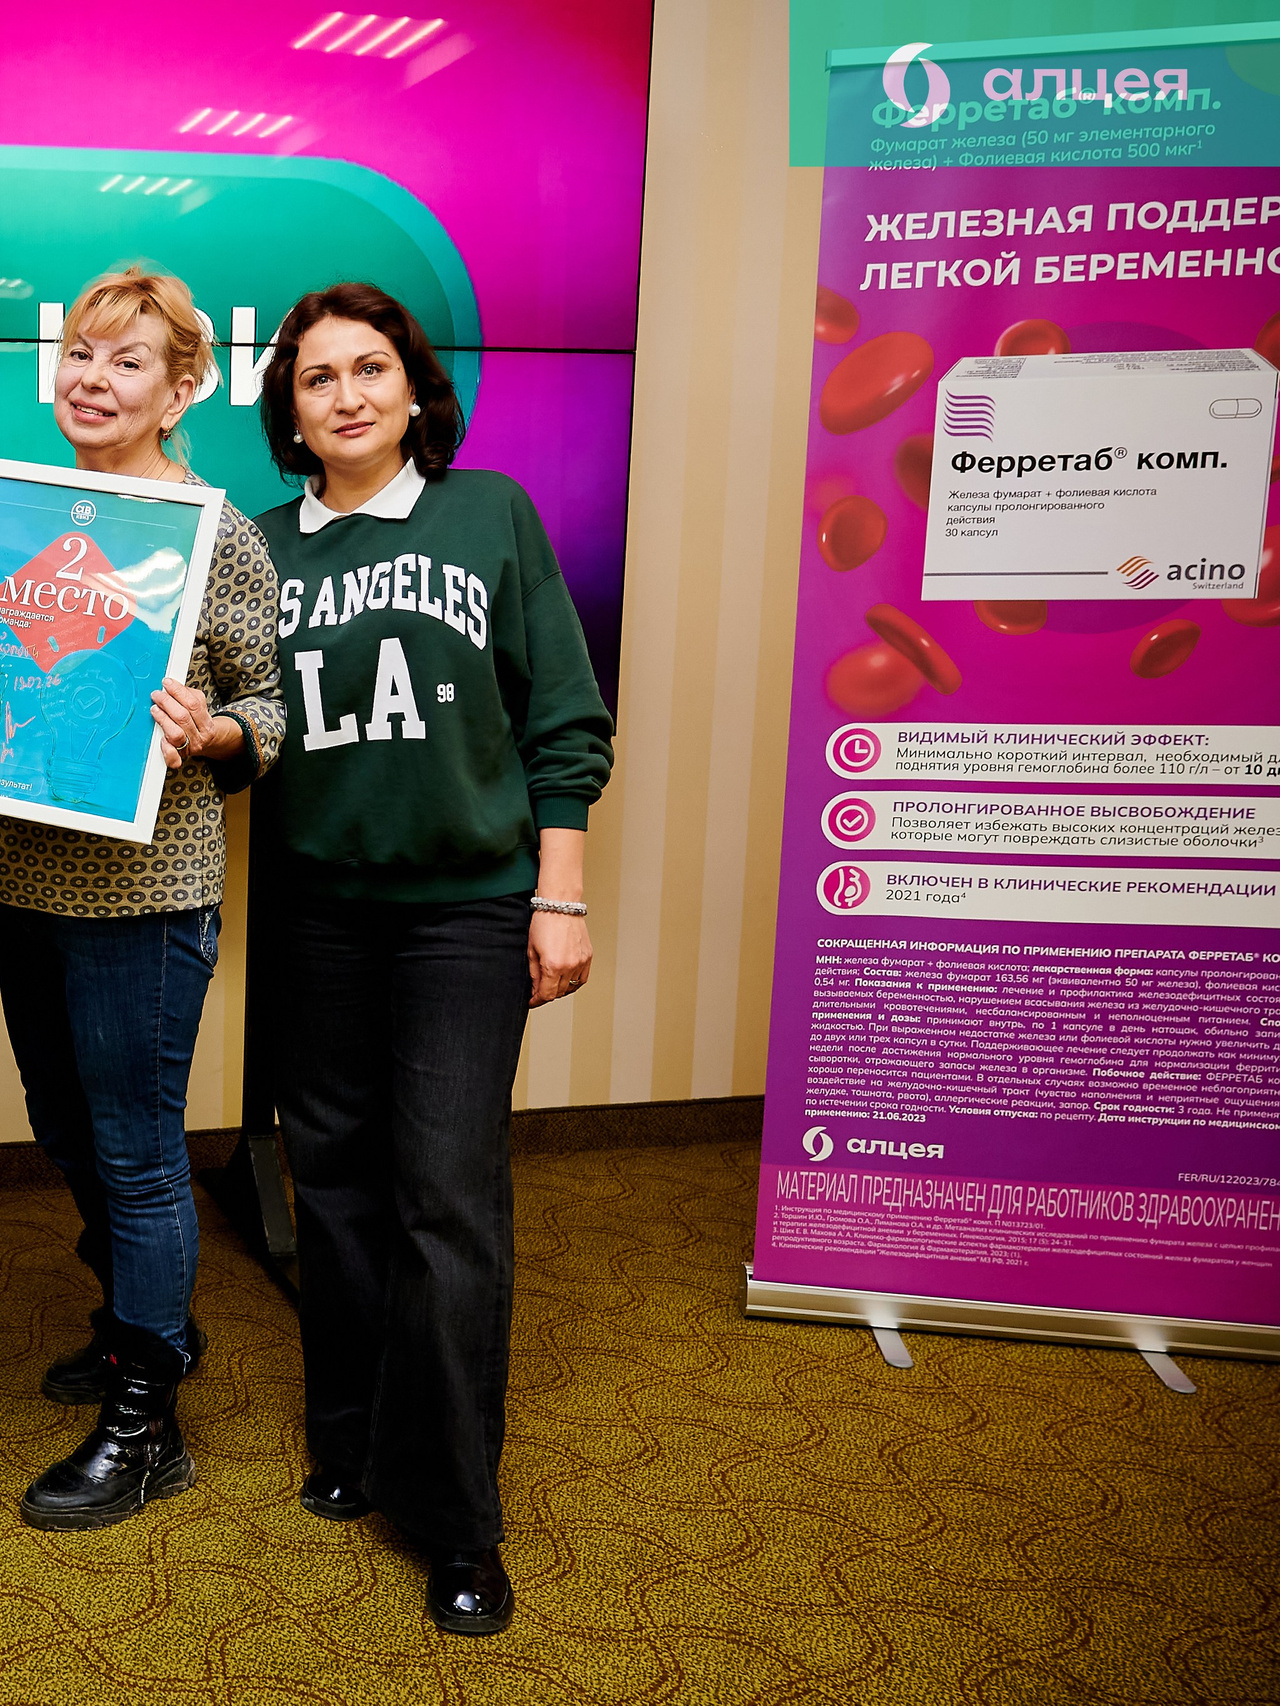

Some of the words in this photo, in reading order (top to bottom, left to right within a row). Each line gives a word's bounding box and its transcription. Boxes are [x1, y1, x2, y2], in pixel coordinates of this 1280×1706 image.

[870, 136, 948, 154] Фумарат
[951, 133, 1017, 150] железа
[1021, 130, 1048, 149] (50
[1053, 131, 1075, 145] мг
[1078, 123, 1215, 142] элементарного
[867, 154, 937, 173] железа)
[958, 149, 1045, 167] Фолиевая
[1050, 146, 1121, 163] кислота
[1127, 142, 1160, 158] 500
[864, 204, 1093, 242] ЖЕЛЕЗНАЯ
[1107, 194, 1280, 234] ПОДДЕР
[860, 250, 1020, 291] ЛЕГКОЙ
[1136, 450, 1228, 471] комп.
[948, 489, 990, 500] Железа
[993, 489, 1042, 500] фумарат
[1056, 488, 1110, 499] фолиевая
[1114, 488, 1157, 497] кислота
[947, 503, 992, 512] капсулы
[995, 501, 1105, 512] пролонгированного
[946, 515, 996, 526] действия
[945, 529, 958, 537] 30
[961, 529, 999, 538] капсул
[56, 537, 87, 581] 2
[1166, 558, 1246, 581] acino
[1192, 582, 1244, 590] Switzerland
[308, 553, 488, 650] ANGELES
[294, 637, 426, 752] LA
[436, 683, 455, 703] 98
[897, 730, 988, 745] ВИДИМЫЙ
[993, 731, 1126, 746] КЛИНИЧЕСКИЙ
[1131, 733, 1209, 746] ЭФФЕКТ:
[896, 748, 993, 761] Минимально
[997, 749, 1068, 763] короткий
[1072, 751, 1147, 764] интервал,
[1155, 751, 1263, 765] необходимый
[895, 761, 959, 773] поднятия
[963, 762, 1014, 775] уровня
[1018, 763, 1109, 776] гемоглобина
[1113, 762, 1155, 775] более
[1159, 763, 1185, 776] 110
[1188, 763, 1209, 776] г/л
[1224, 766, 1240, 775] от
[1245, 764, 1262, 775] 10
[893, 801, 1086, 818] ПРОЛОНГИРОВАННОЕ
[1090, 806, 1256, 822] ВЫСВОБОЖДЕНИЕ
[891, 817, 971, 830] Позволяет
[975, 819, 1047, 833] избежать
[1052, 822, 1115, 834] высоких
[1119, 822, 1229, 837] концентраций
[891, 830, 953, 843] которые
[957, 833, 1000, 846] могут
[1003, 834, 1096, 847] повреждать
[1100, 835, 1179, 847] слизистые
[886, 890, 921, 902] 2021
[887, 874, 972, 887] ВКЛЮЧЕН
[978, 878, 988, 889] В
[993, 878, 1122, 893] КЛИНИЧЕСКИЕ
[1127, 881, 1276, 897] РЕКОМЕНДАЦИИ
[817, 939, 907, 950] СОКРАЩЕННАЯ
[910, 941, 999, 955] ИНФОРМАЦИЯ
[1002, 946, 1020, 955] ПО
[1024, 946, 1111, 958] ПРИМЕНЕНИЮ
[1115, 949, 1185, 960] ПРЕПАРАТА
[816, 956, 842, 964] МНН:
[844, 957, 879, 965] железа
[881, 957, 925, 967] фумарат
[936, 959, 985, 970] фолиевая
[1032, 966, 1111, 975] лекарственная
[1114, 966, 1153, 976] форма:
[1156, 969, 1198, 978] капсулы
[863, 968, 901, 977] Состав:
[905, 971, 943, 979] железа
[947, 971, 991, 983] фумарат
[1048, 976, 1121, 987] (эквивалентно
[1125, 979, 1138, 987] 50
[1205, 980, 1257, 991] фолиевая
[855, 979, 911, 989] Показания
[928, 983, 997, 994] применению:
[1002, 986, 1044, 996] лечение
[1060, 988, 1133, 999] профилактика
[1138, 991, 1241, 1003] железодефицитных
[812, 1011, 871, 1022] применения
[891, 1014, 921, 1023] дозы:
[1093, 1069, 1145, 1078] Побочное
[1150, 1071, 1201, 1081] действие:
[1206, 1072, 1263, 1084] ФЕРРЕТАБ
[805, 1109, 869, 1119] применению:
[873, 1111, 926, 1122] 21.06.2023
[949, 1104, 991, 1116] Условия
[994, 1109, 1038, 1119] отпуска:
[1040, 1113, 1052, 1121] по
[1098, 1113, 1125, 1123] Дата
[1128, 1115, 1190, 1127] инструкции
[1193, 1118, 1206, 1126] по
[1094, 1102, 1120, 1111] Срок
[1123, 1104, 1175, 1114] годности:
[847, 1137, 944, 1159] алцея
[776, 1170, 858, 1203] МАТЕРИАЛ
[861, 1175, 985, 1213] ПРЕДНАЗНАЧЕН
[987, 1184, 1023, 1219] ДЛЯ
[1026, 1187, 1134, 1222] РАБОТНИКОВ
